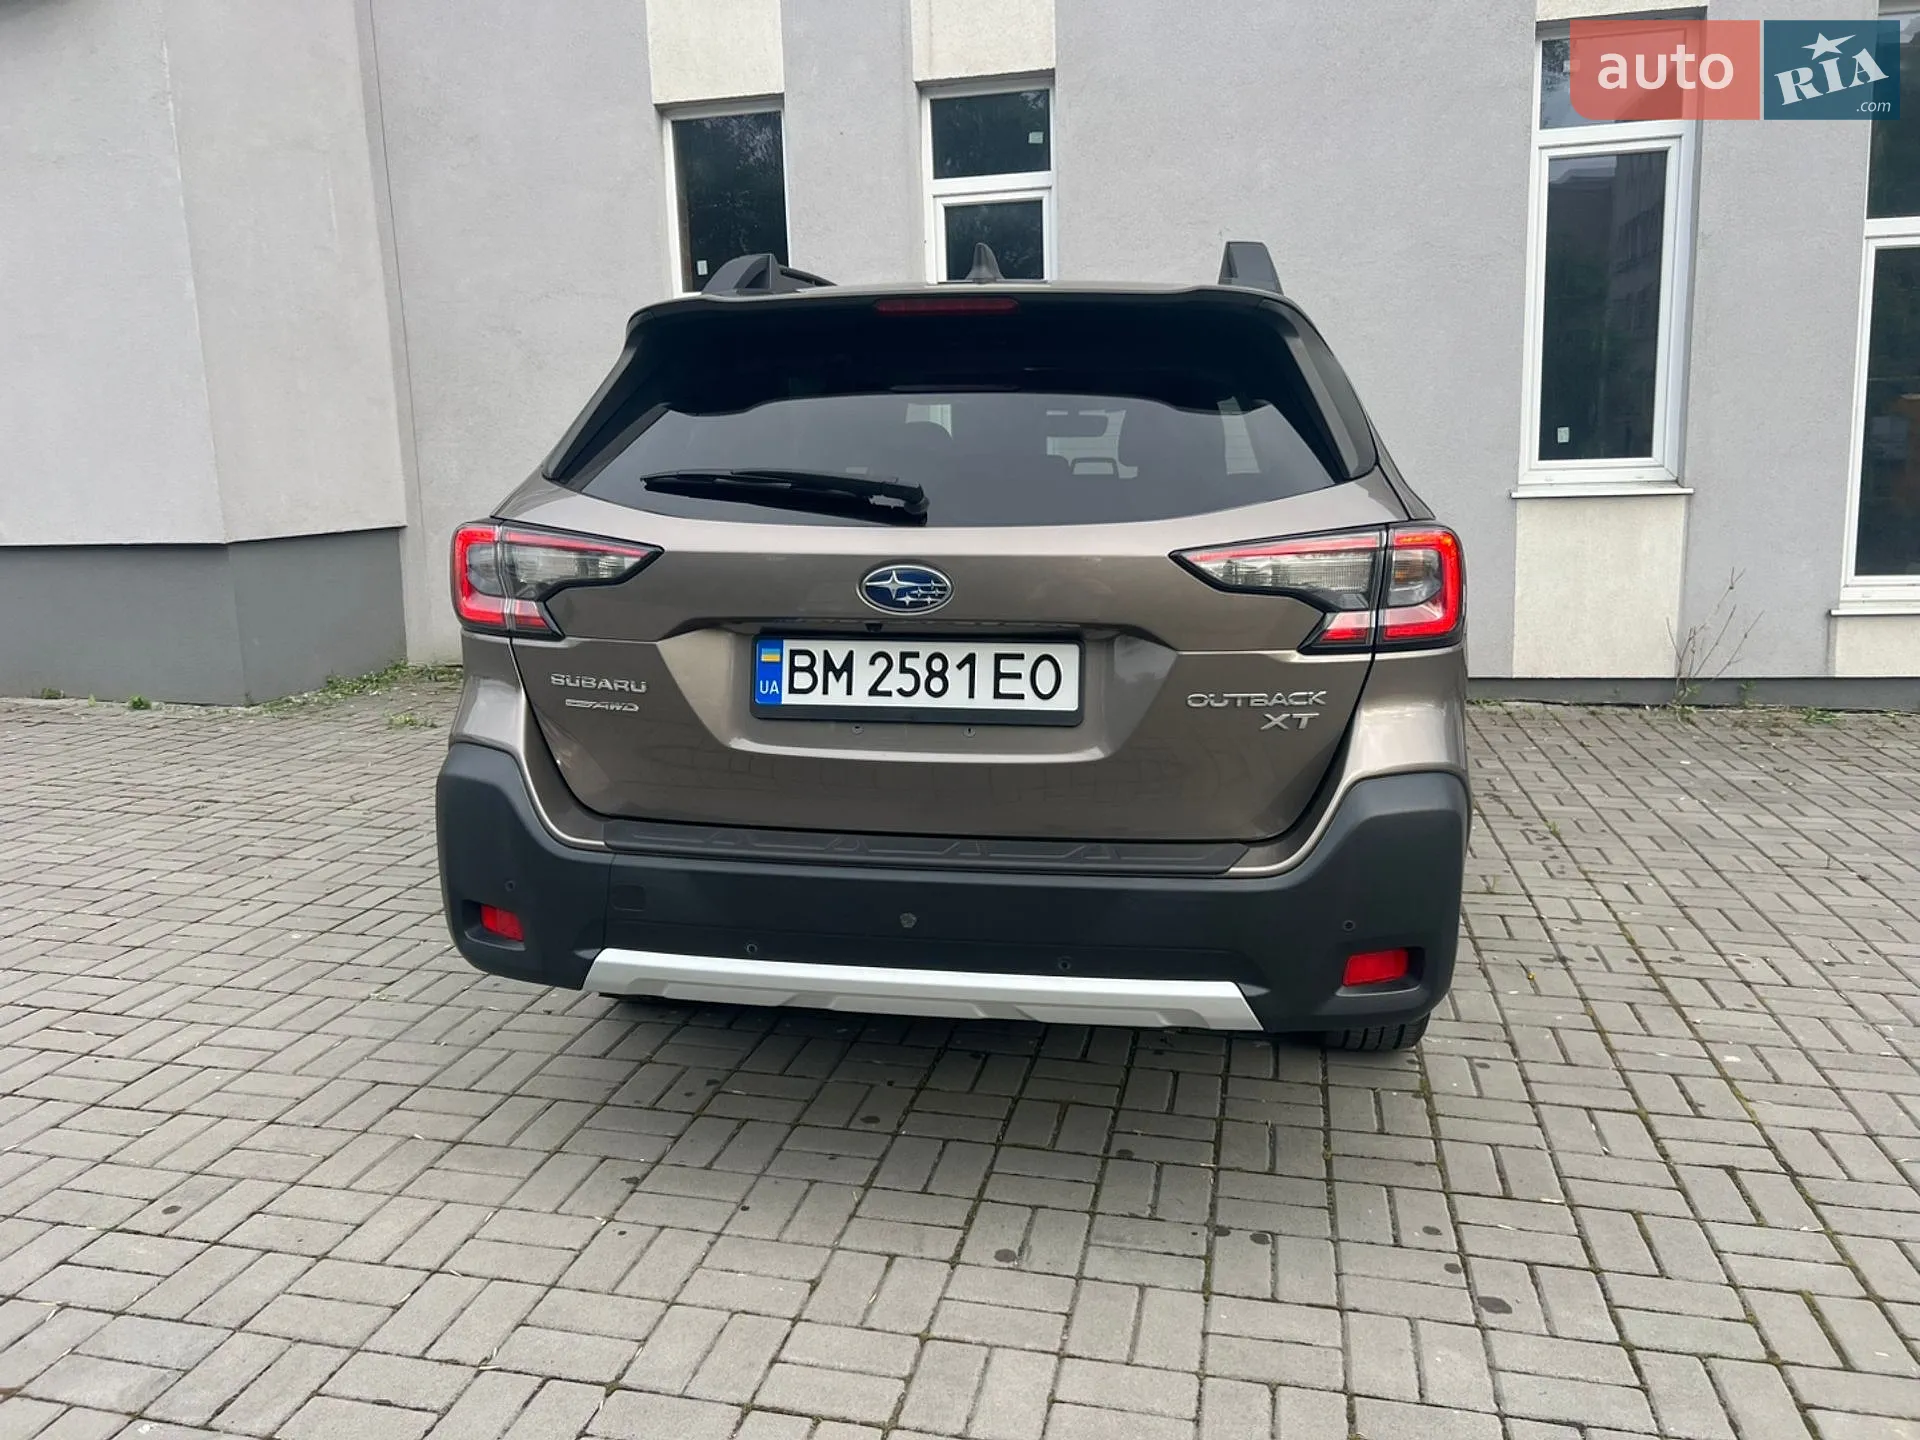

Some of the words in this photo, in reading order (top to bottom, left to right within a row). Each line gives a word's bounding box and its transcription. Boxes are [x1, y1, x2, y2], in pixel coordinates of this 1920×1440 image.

[550, 673, 648, 693] SUBARU
[787, 648, 855, 696] BM
[867, 650, 977, 700] 2581
[992, 652, 1063, 701] EO
[759, 679, 780, 696] UA
[1186, 690, 1328, 708] OUTBACK
[1260, 712, 1321, 731] XT
